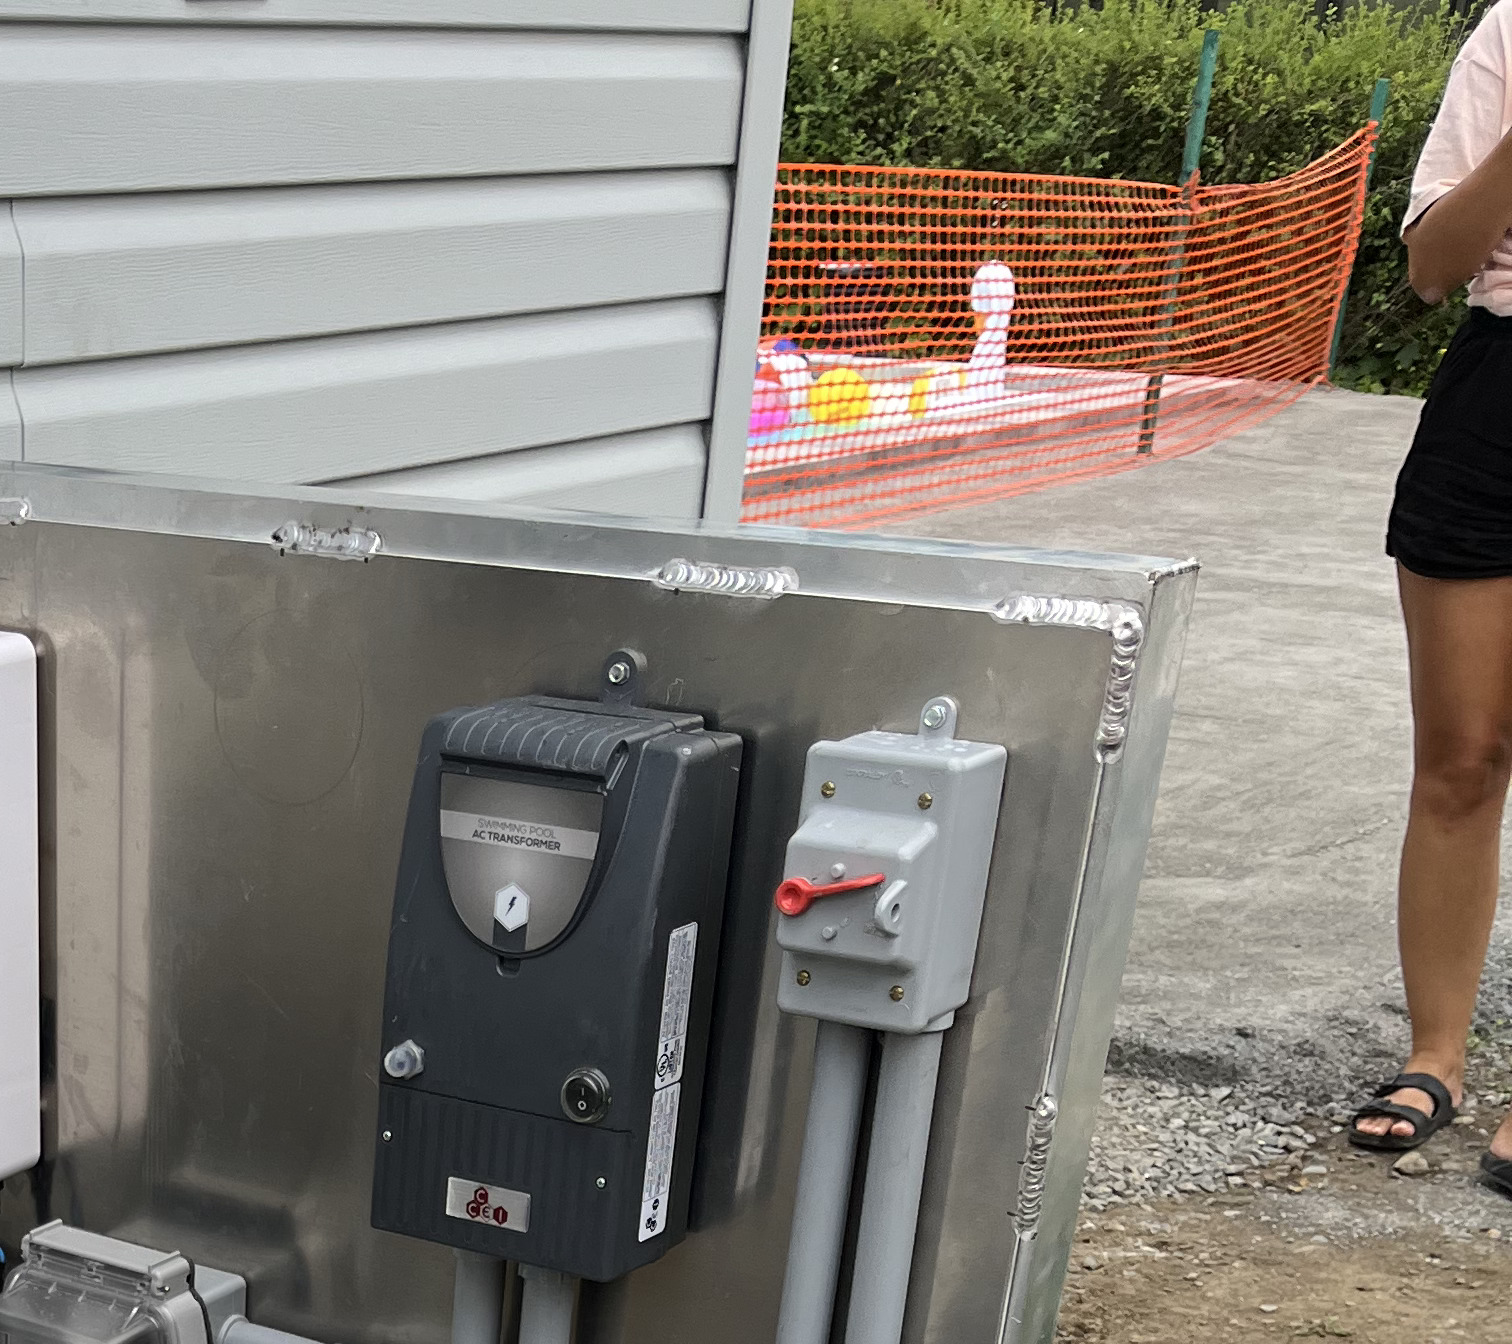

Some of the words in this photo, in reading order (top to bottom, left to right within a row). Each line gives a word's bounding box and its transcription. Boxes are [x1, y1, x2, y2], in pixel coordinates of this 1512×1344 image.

[477, 818, 527, 835] SWIMMING
[529, 825, 556, 838] POOL
[472, 829, 486, 840] AC
[487, 831, 561, 851] TRANSFORMER
